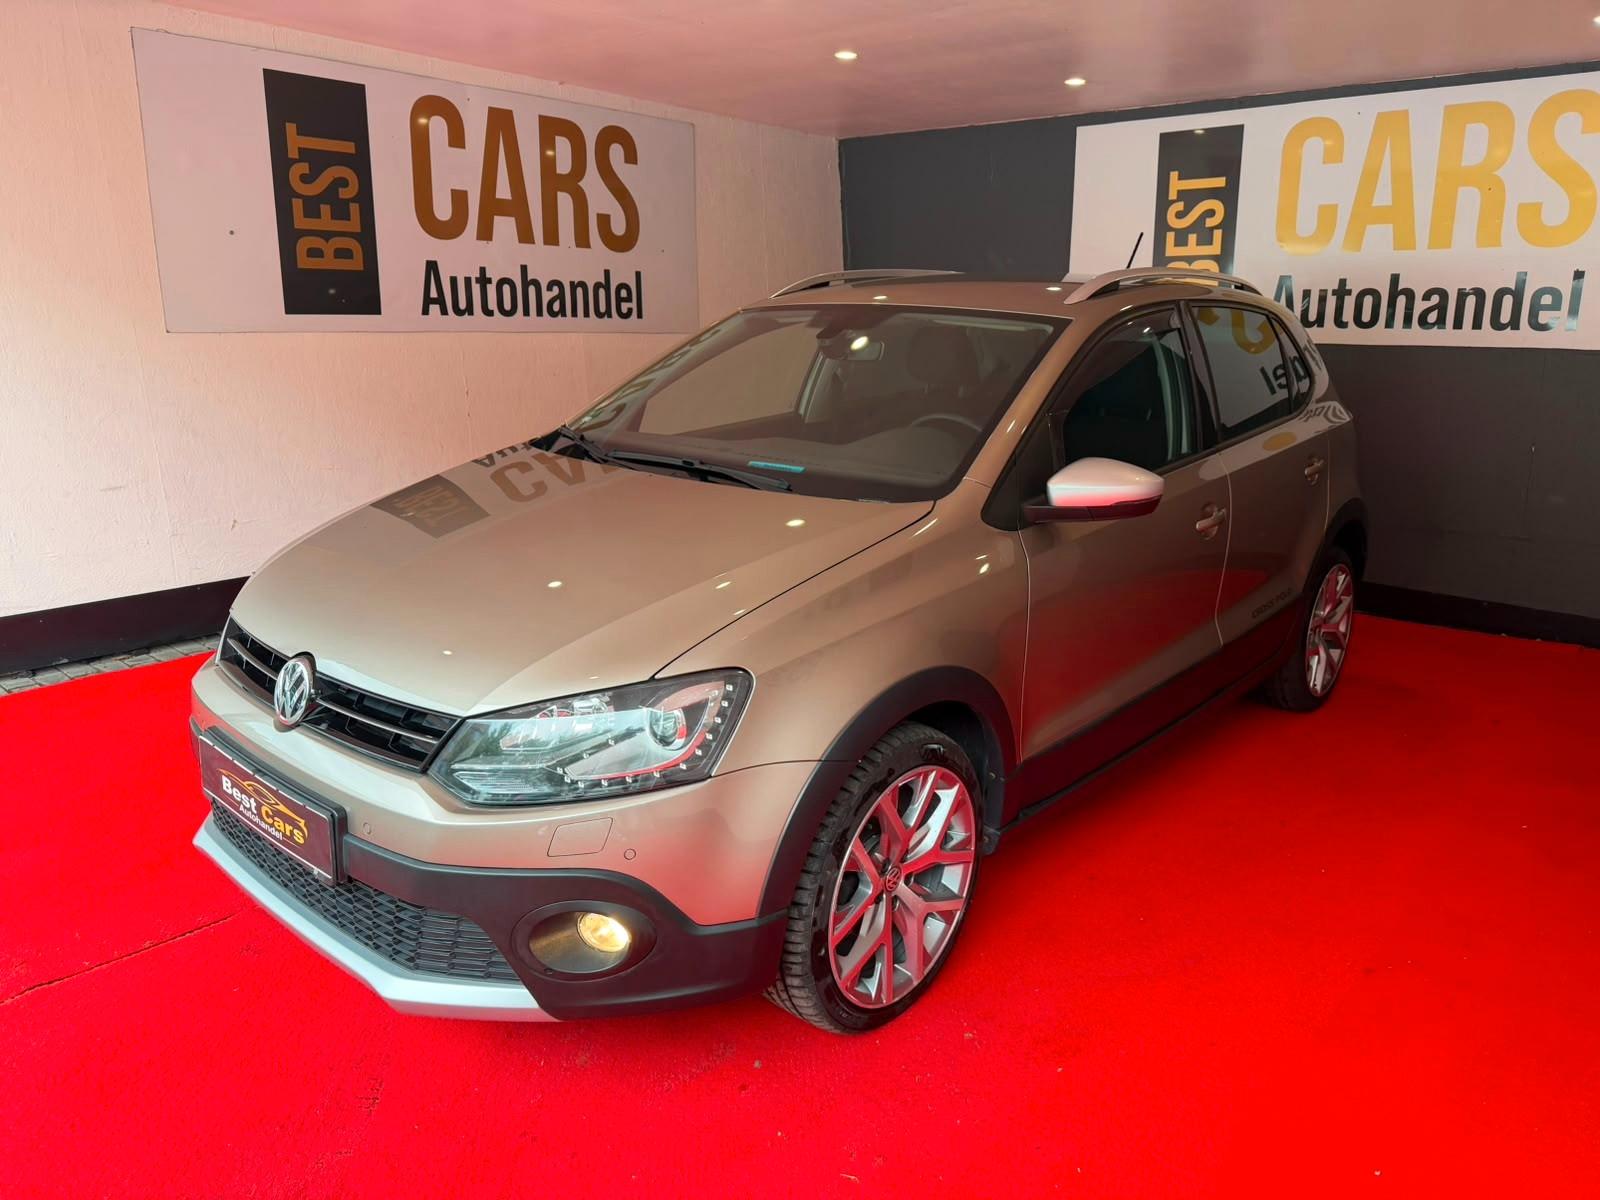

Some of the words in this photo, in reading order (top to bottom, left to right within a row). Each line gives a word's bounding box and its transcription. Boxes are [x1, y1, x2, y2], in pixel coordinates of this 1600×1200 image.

[285, 122, 365, 271] BEST
[409, 94, 641, 254] CARS
[1275, 88, 1600, 256] CARS
[421, 259, 643, 320] Autohandel
[1272, 268, 1586, 332] Autohandel
[221, 774, 257, 814] Best
[261, 805, 305, 845] Cars
[239, 803, 283, 841] Autohandel
